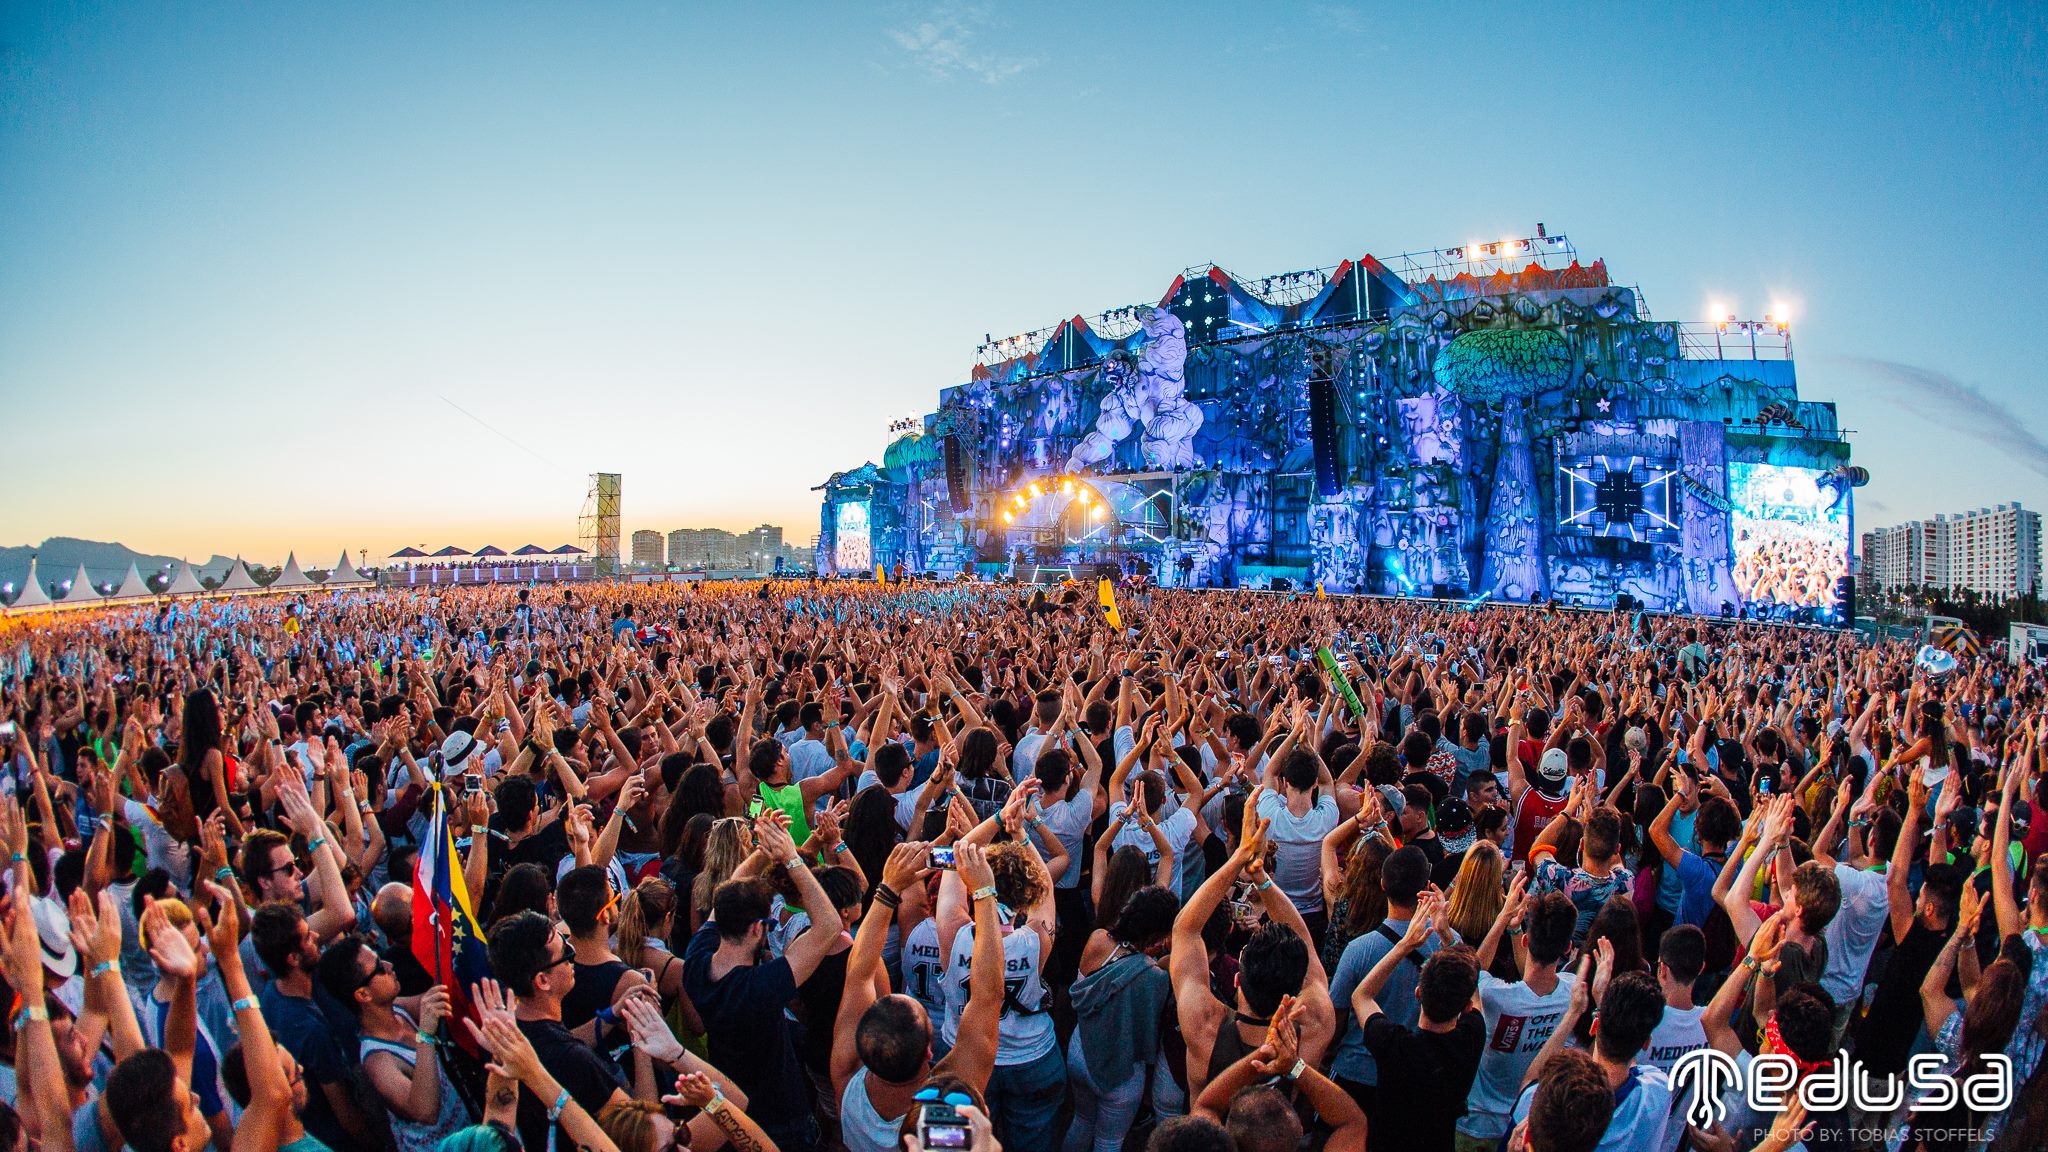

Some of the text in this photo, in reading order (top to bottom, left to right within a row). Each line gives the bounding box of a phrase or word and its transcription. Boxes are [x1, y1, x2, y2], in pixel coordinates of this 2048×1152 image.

[912, 944, 940, 957] MED
[1527, 1026, 1554, 1040] THE
[1522, 1041, 1547, 1053] WA
